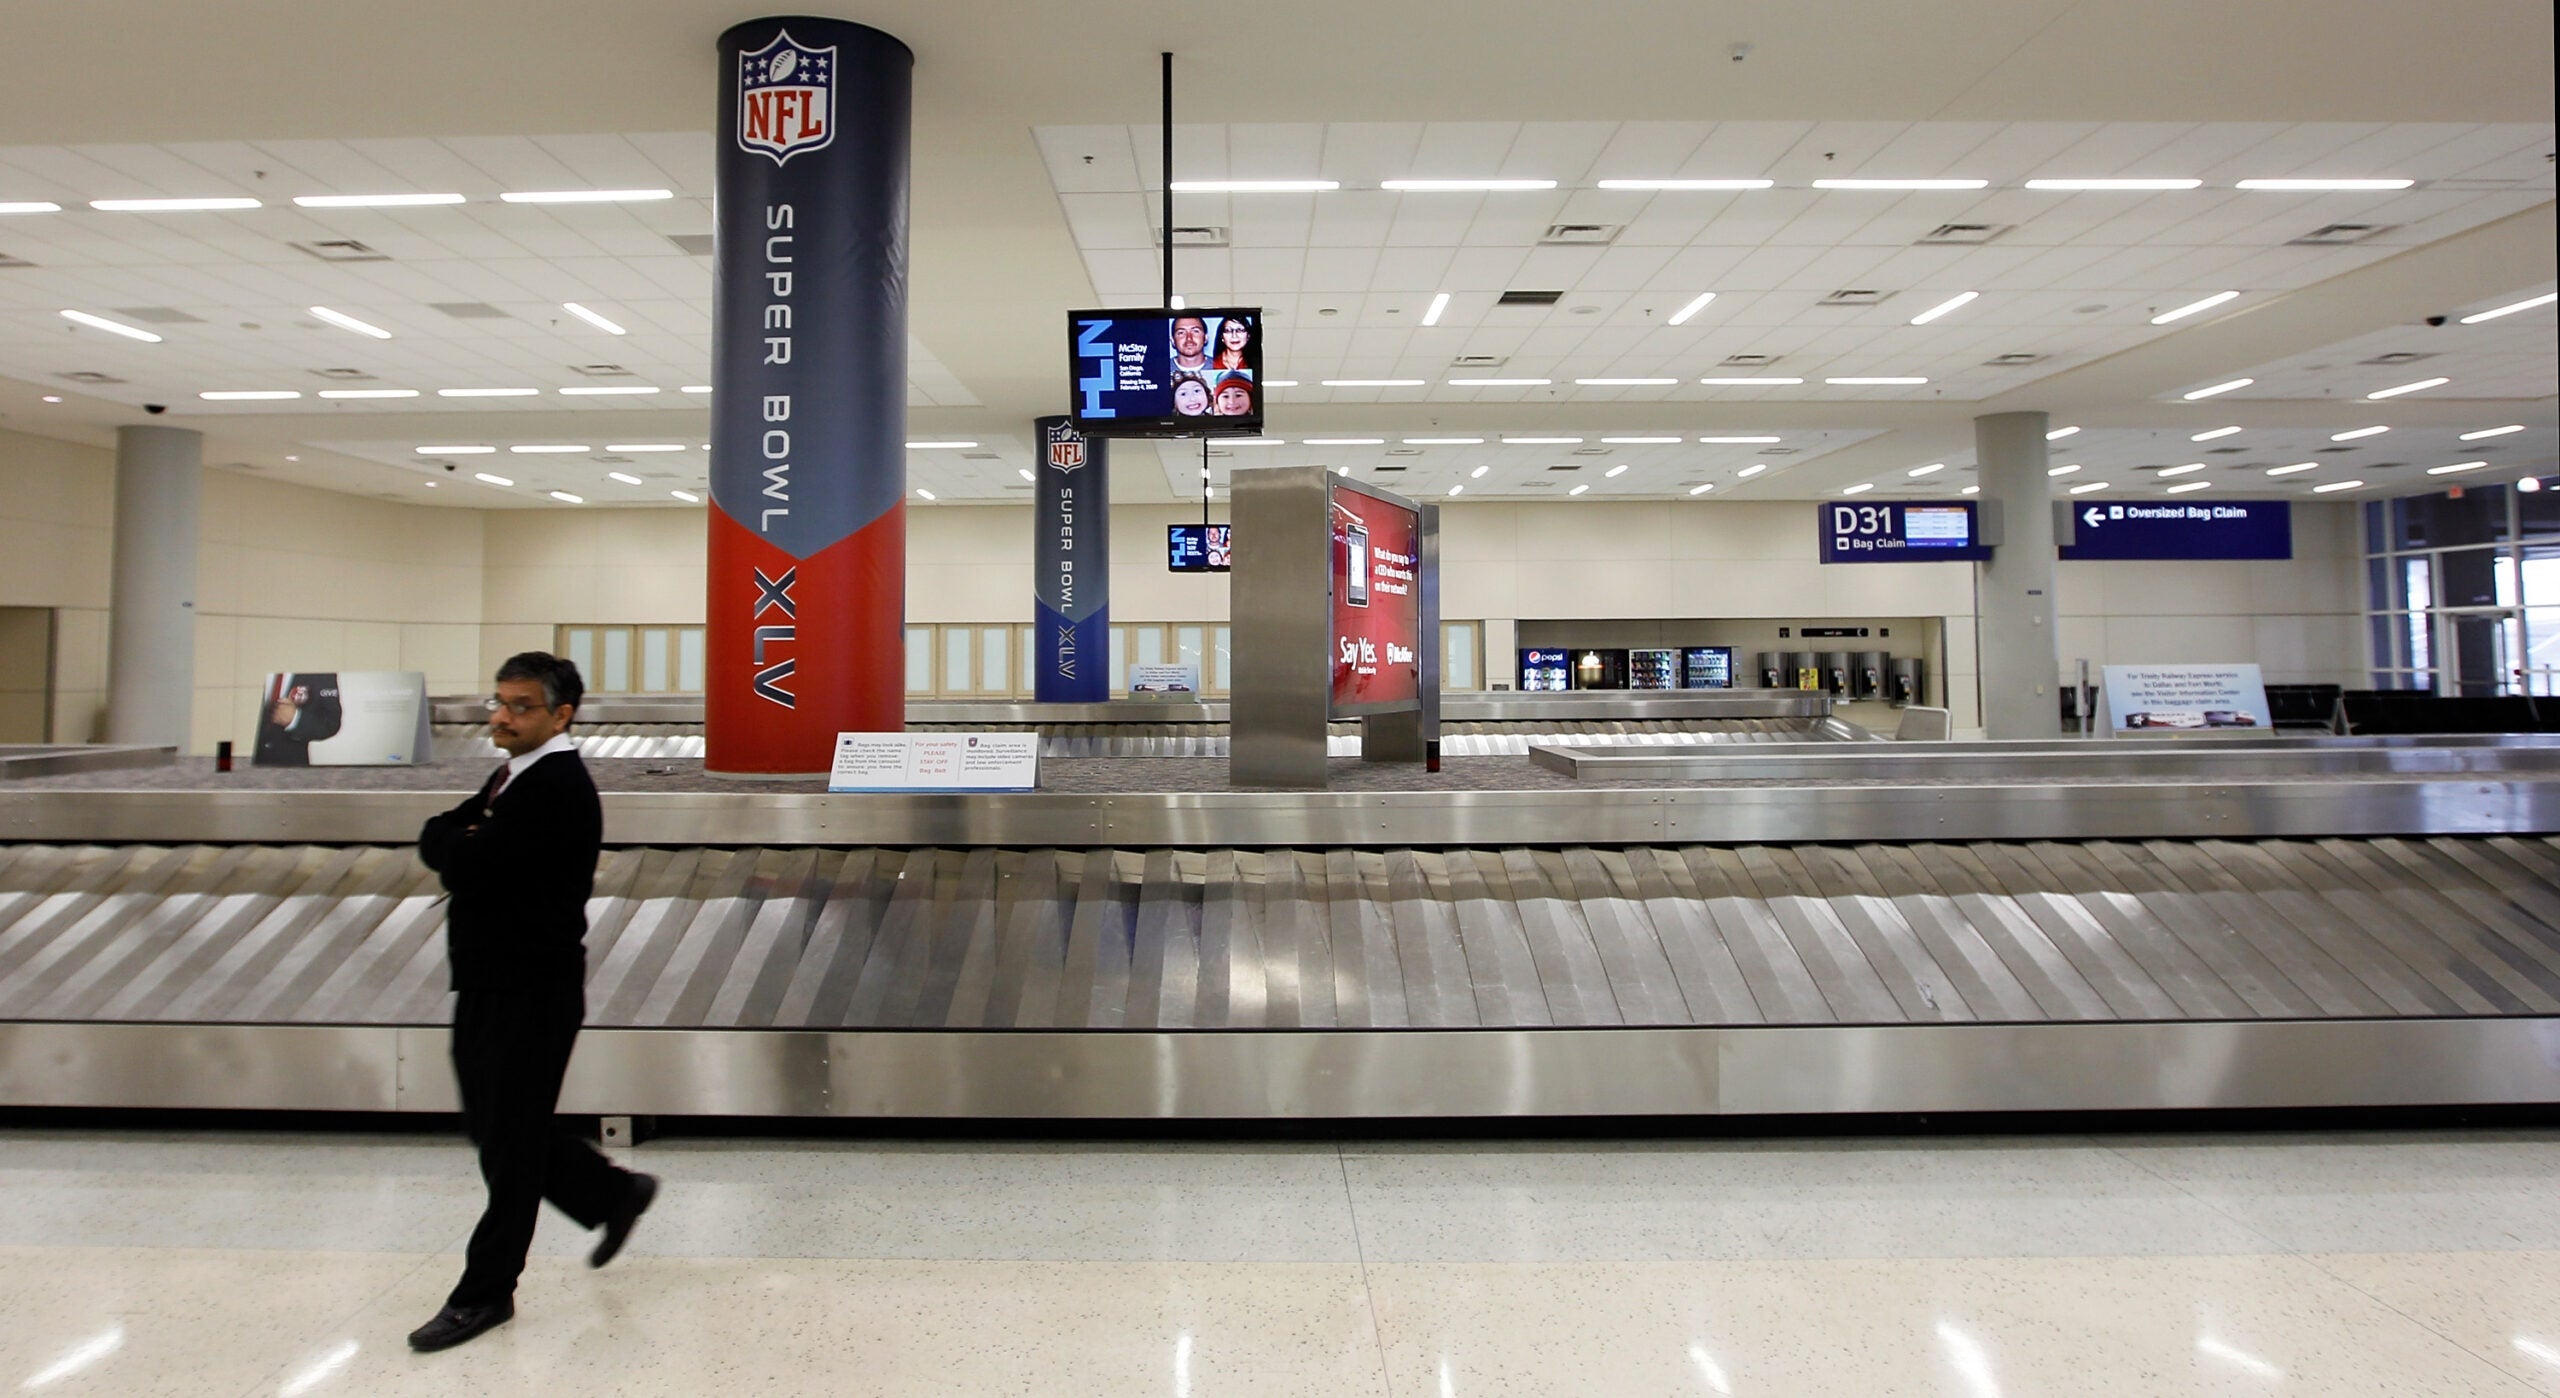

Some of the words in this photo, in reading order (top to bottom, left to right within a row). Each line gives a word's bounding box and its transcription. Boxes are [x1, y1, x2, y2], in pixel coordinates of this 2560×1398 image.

[746, 90, 822, 146] NFL
[763, 203, 794, 366] SUPER
[1077, 319, 1116, 418] HLN
[1119, 353, 1145, 363] Family
[761, 394, 792, 533] BOWL
[1052, 444, 1082, 466] NFL
[1060, 488, 1072, 551] SUPER
[1835, 507, 1891, 534] D31
[2128, 506, 2184, 518] Oversized
[2186, 507, 2211, 521] Bag
[2212, 507, 2247, 518] Claim
[1171, 528, 1186, 566] HLN
[1853, 539, 1874, 551] Bag
[1876, 538, 1905, 548] Claim
[1061, 560, 1072, 613] BOWL
[753, 564, 796, 710] XLV
[1058, 625, 1076, 680] XLV
[1340, 636, 1358, 670] Say
[1359, 637, 1377, 663] Yes.
[1541, 653, 1563, 663] pepsi
